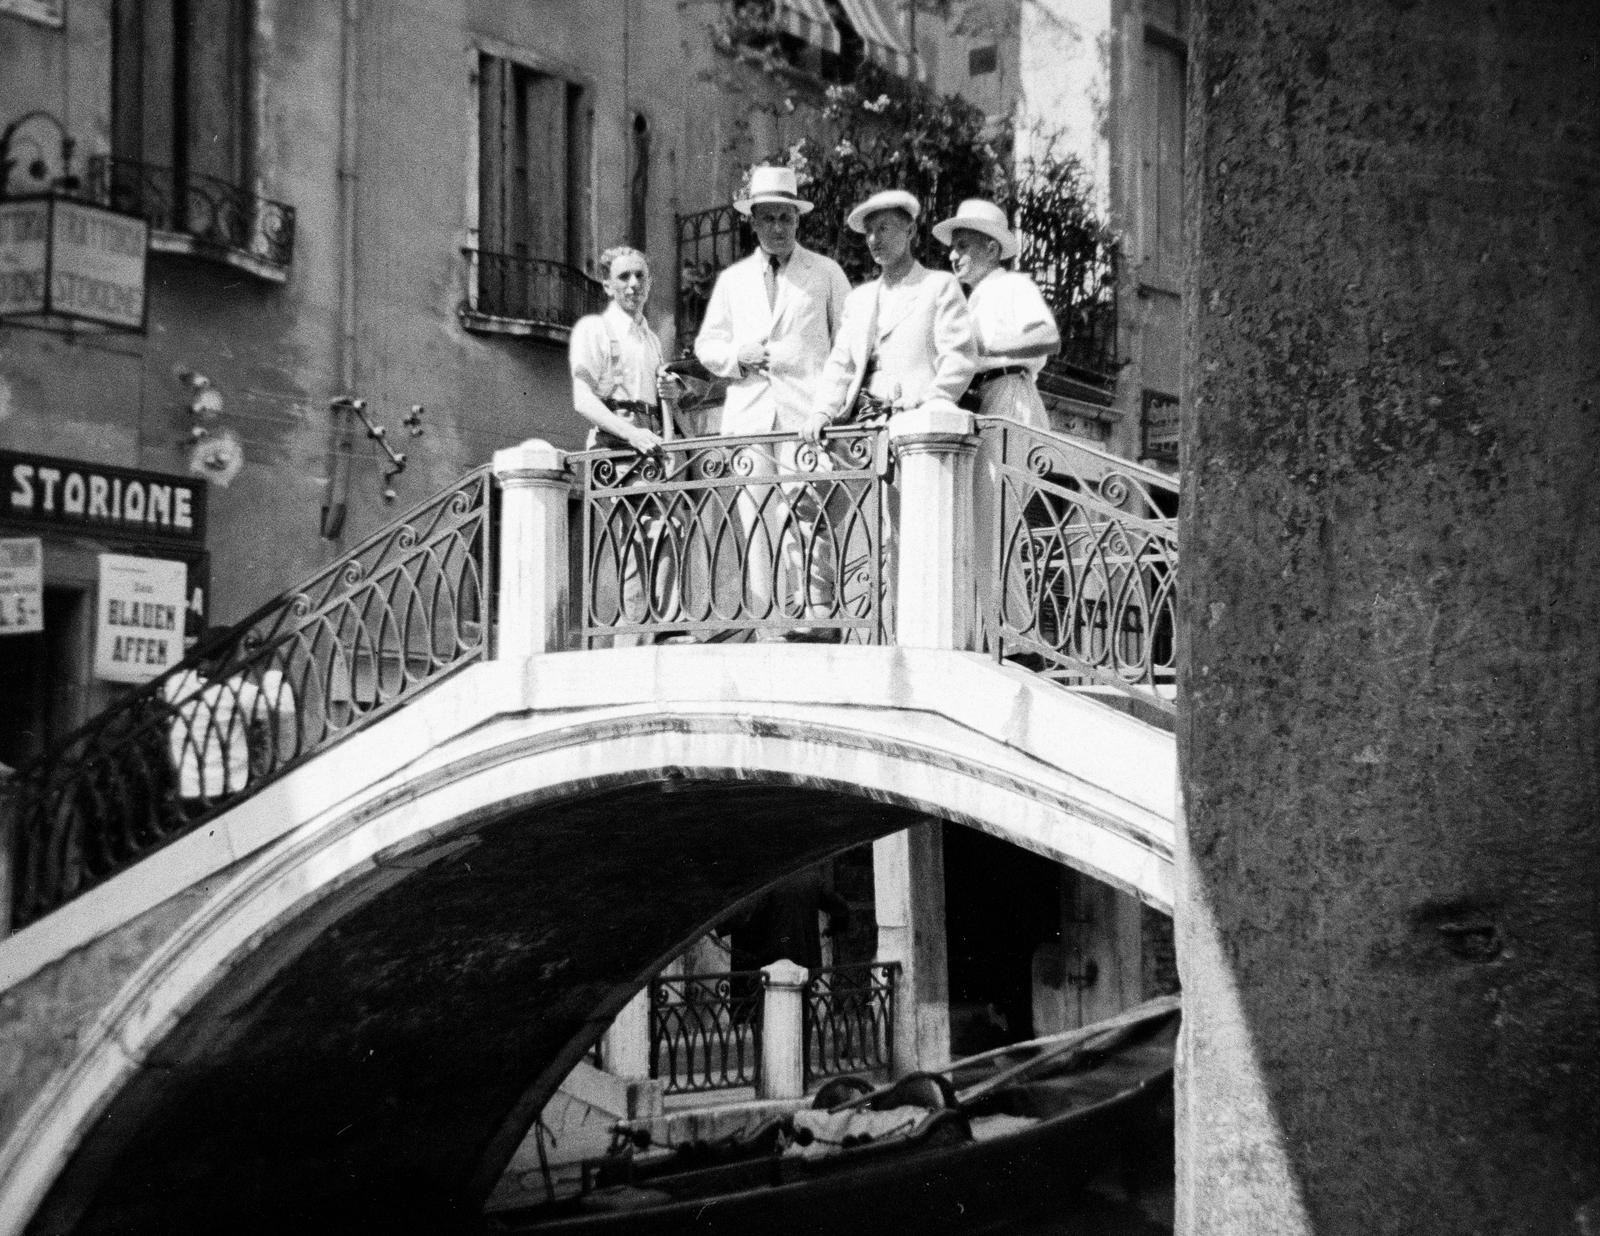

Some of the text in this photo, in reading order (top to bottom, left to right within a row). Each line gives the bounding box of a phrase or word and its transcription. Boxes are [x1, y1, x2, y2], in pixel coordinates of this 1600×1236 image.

[11, 464, 193, 528] STORIONE
[108, 599, 176, 631] BLAUEN
[112, 635, 168, 665] AFFEN
